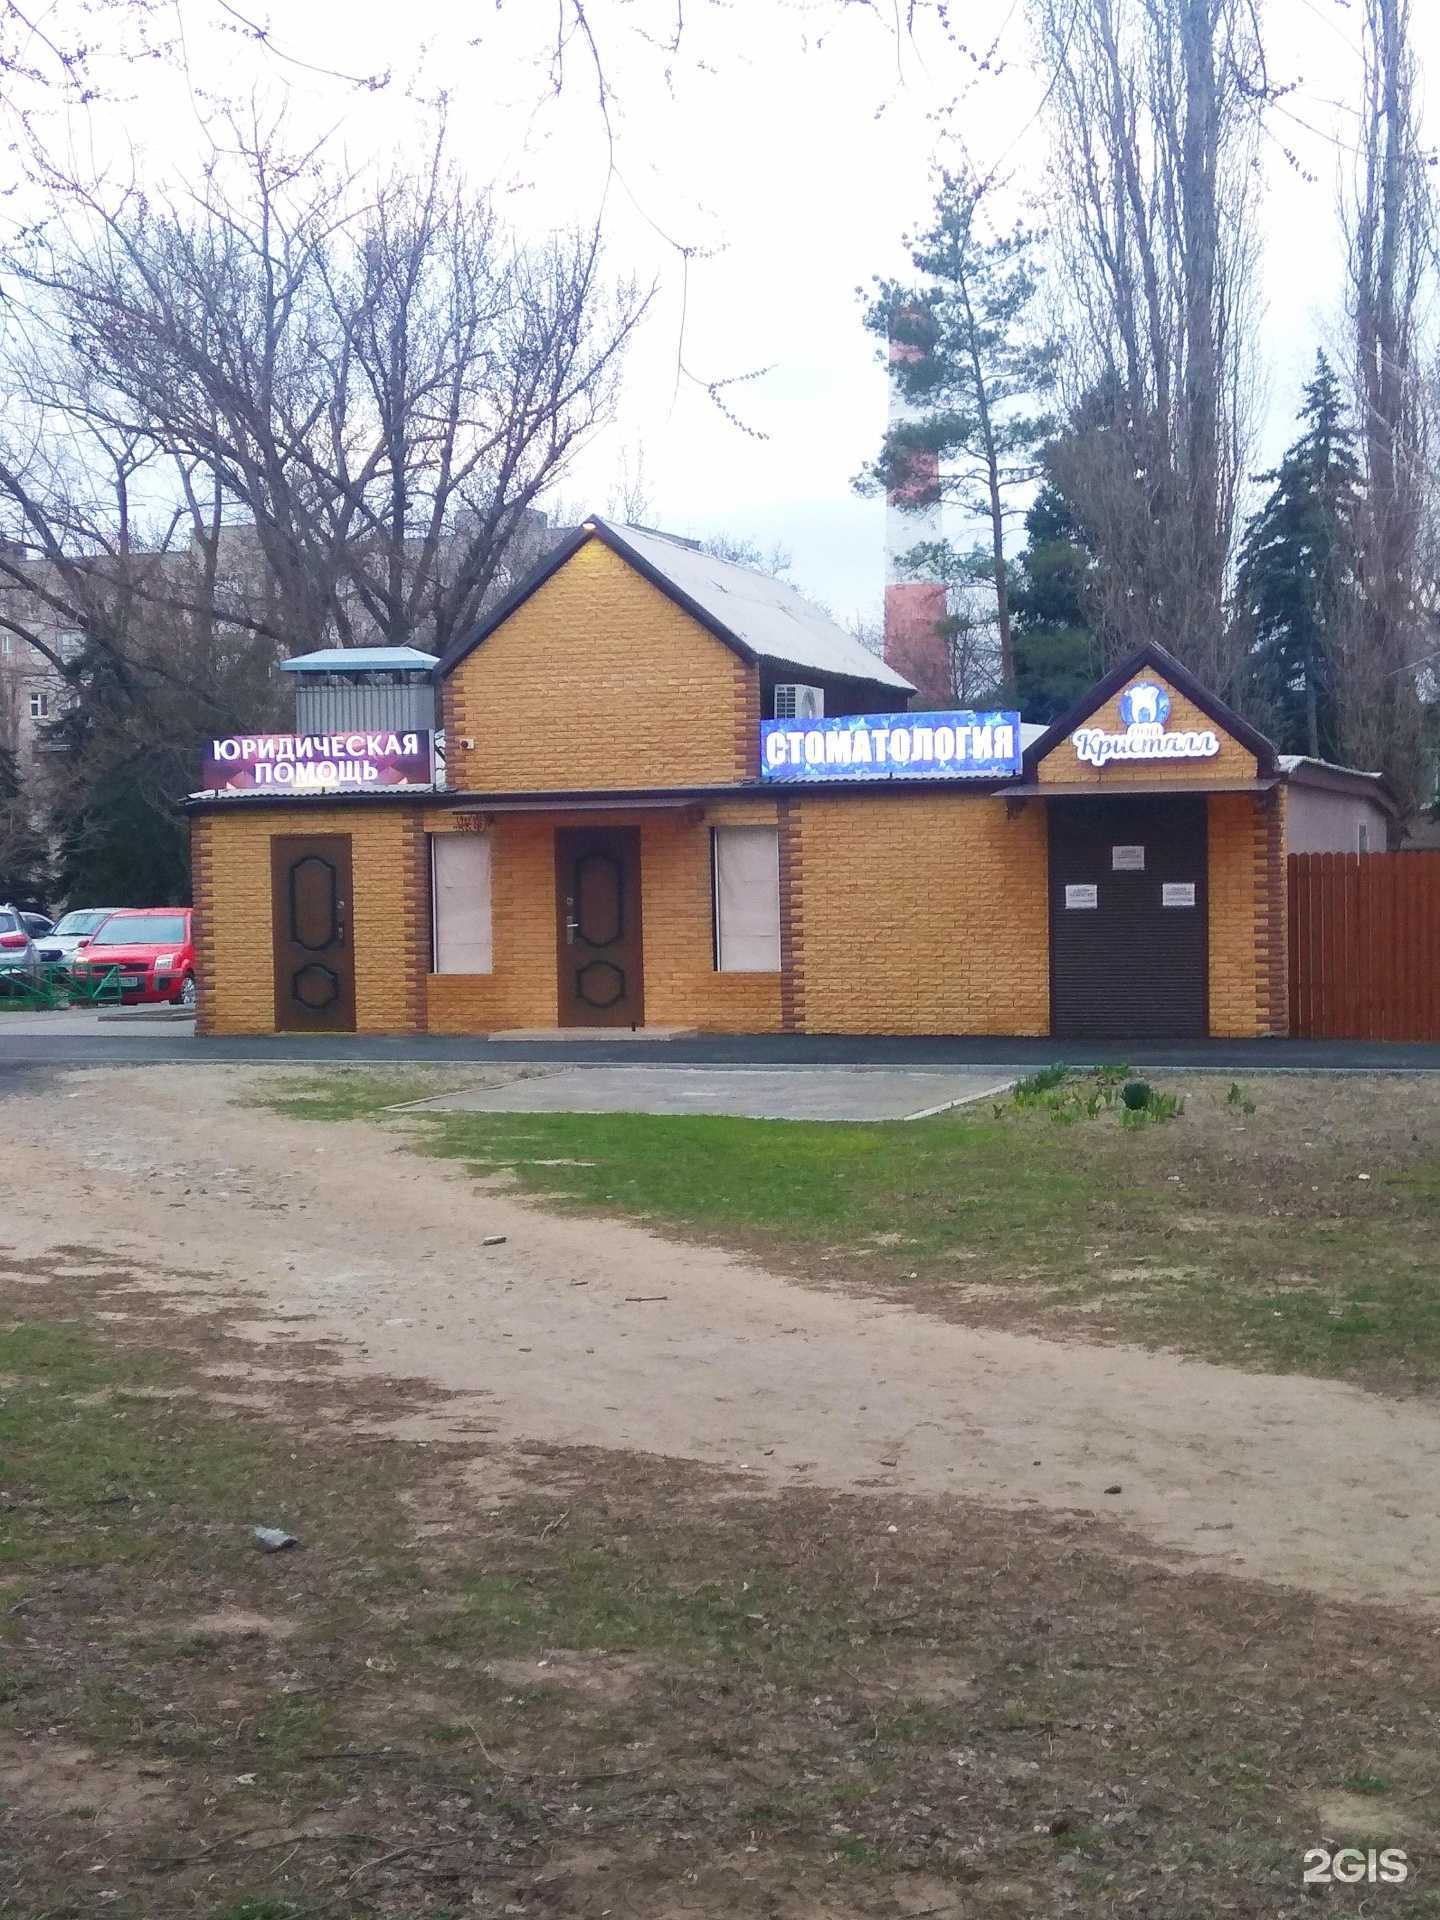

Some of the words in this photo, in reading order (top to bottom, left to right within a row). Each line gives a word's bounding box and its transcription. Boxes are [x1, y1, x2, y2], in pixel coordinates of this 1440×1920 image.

[213, 734, 418, 761] ЮРИДИЧЕСКАЯ
[766, 725, 1014, 765] СТОМАТОЛОГИЯ
[1076, 733, 1214, 761] Кристалл
[254, 760, 379, 784] ПОМОЩЬ
